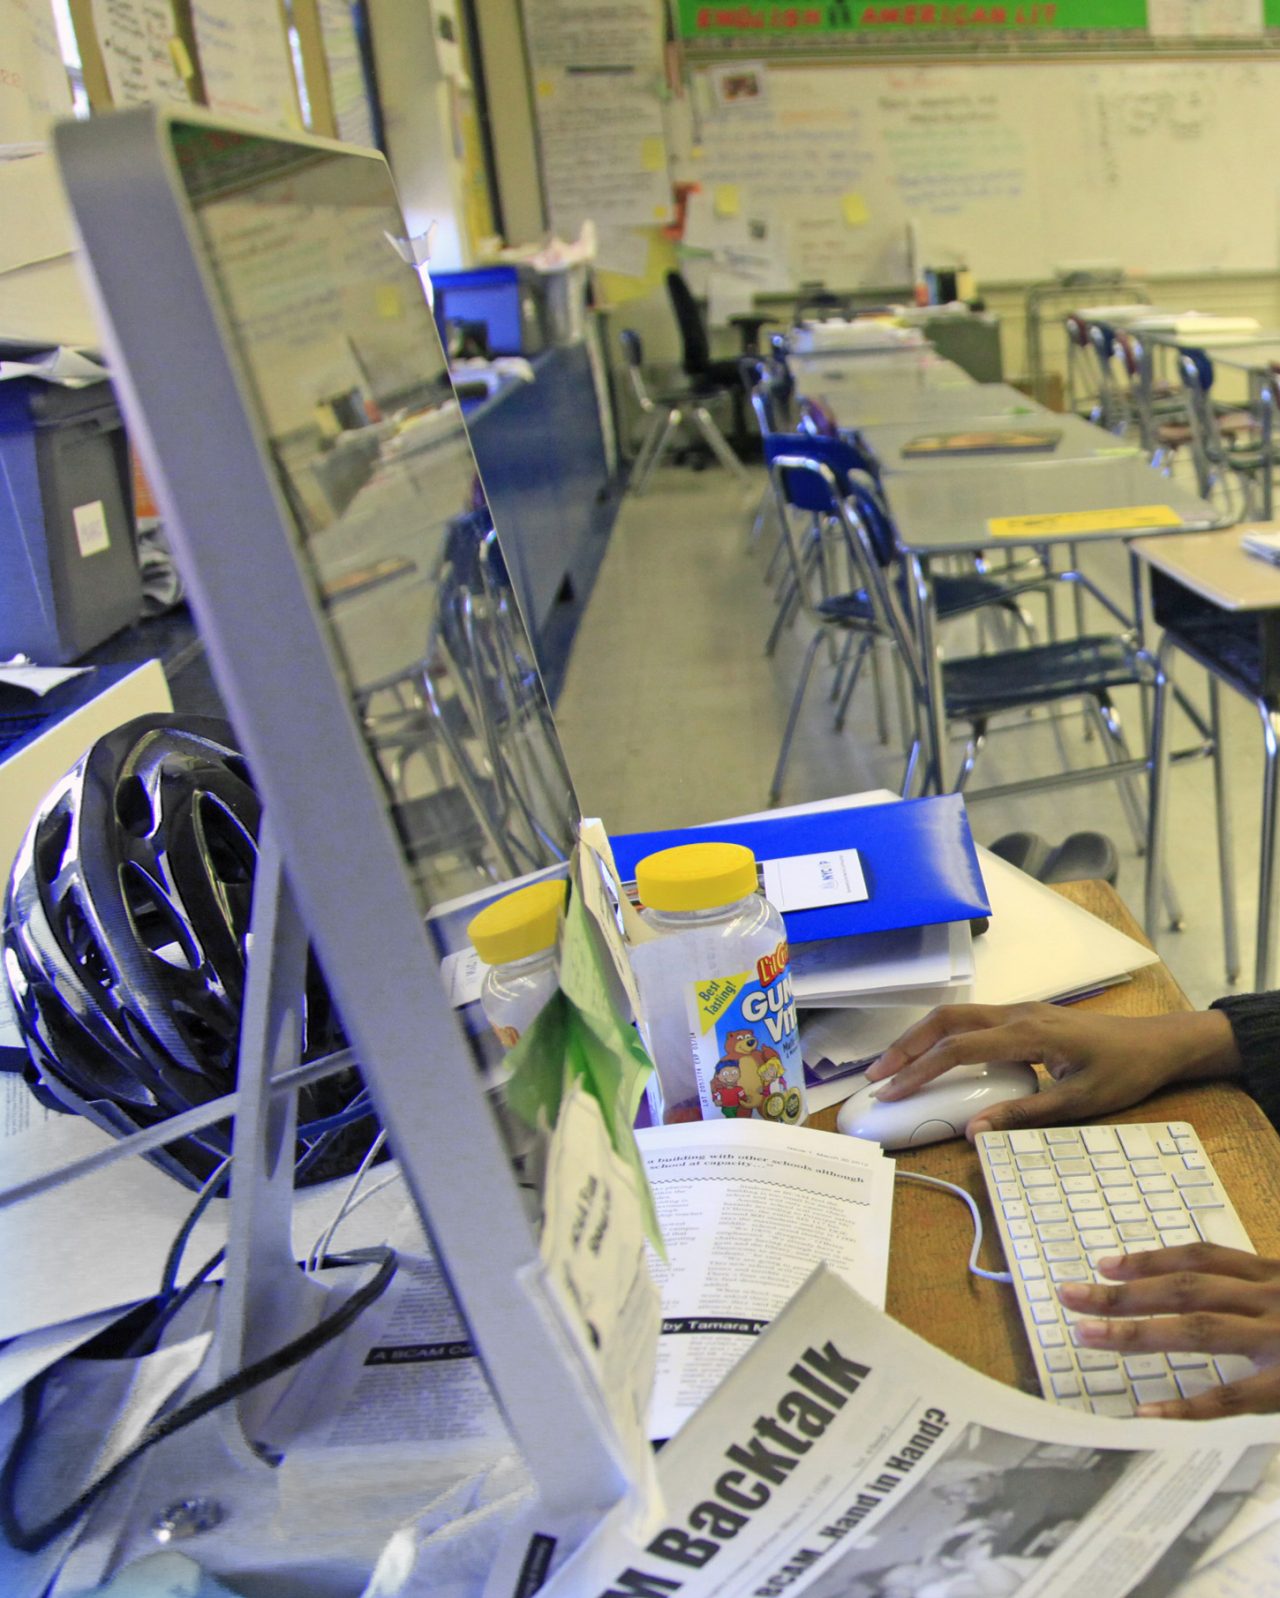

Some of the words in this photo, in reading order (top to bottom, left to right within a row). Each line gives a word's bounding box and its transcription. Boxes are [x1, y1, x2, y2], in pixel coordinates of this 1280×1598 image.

[860, 5, 1006, 26] AMERICAN
[1013, 4, 1057, 25] LIT
[698, 980, 720, 1002] Best
[703, 980, 737, 1016] Tasting!
[650, 1162, 686, 1171] school
[657, 1154, 706, 1164] building
[738, 1154, 768, 1163] other
[772, 1158, 813, 1172] schools
[815, 1168, 865, 1184] although
[663, 1321, 684, 1332] by
[688, 1320, 749, 1332] Tamara
[644, 1340, 873, 1569] Backtalk
[864, 1473, 902, 1494] in
[884, 1407, 950, 1473] Hand?
